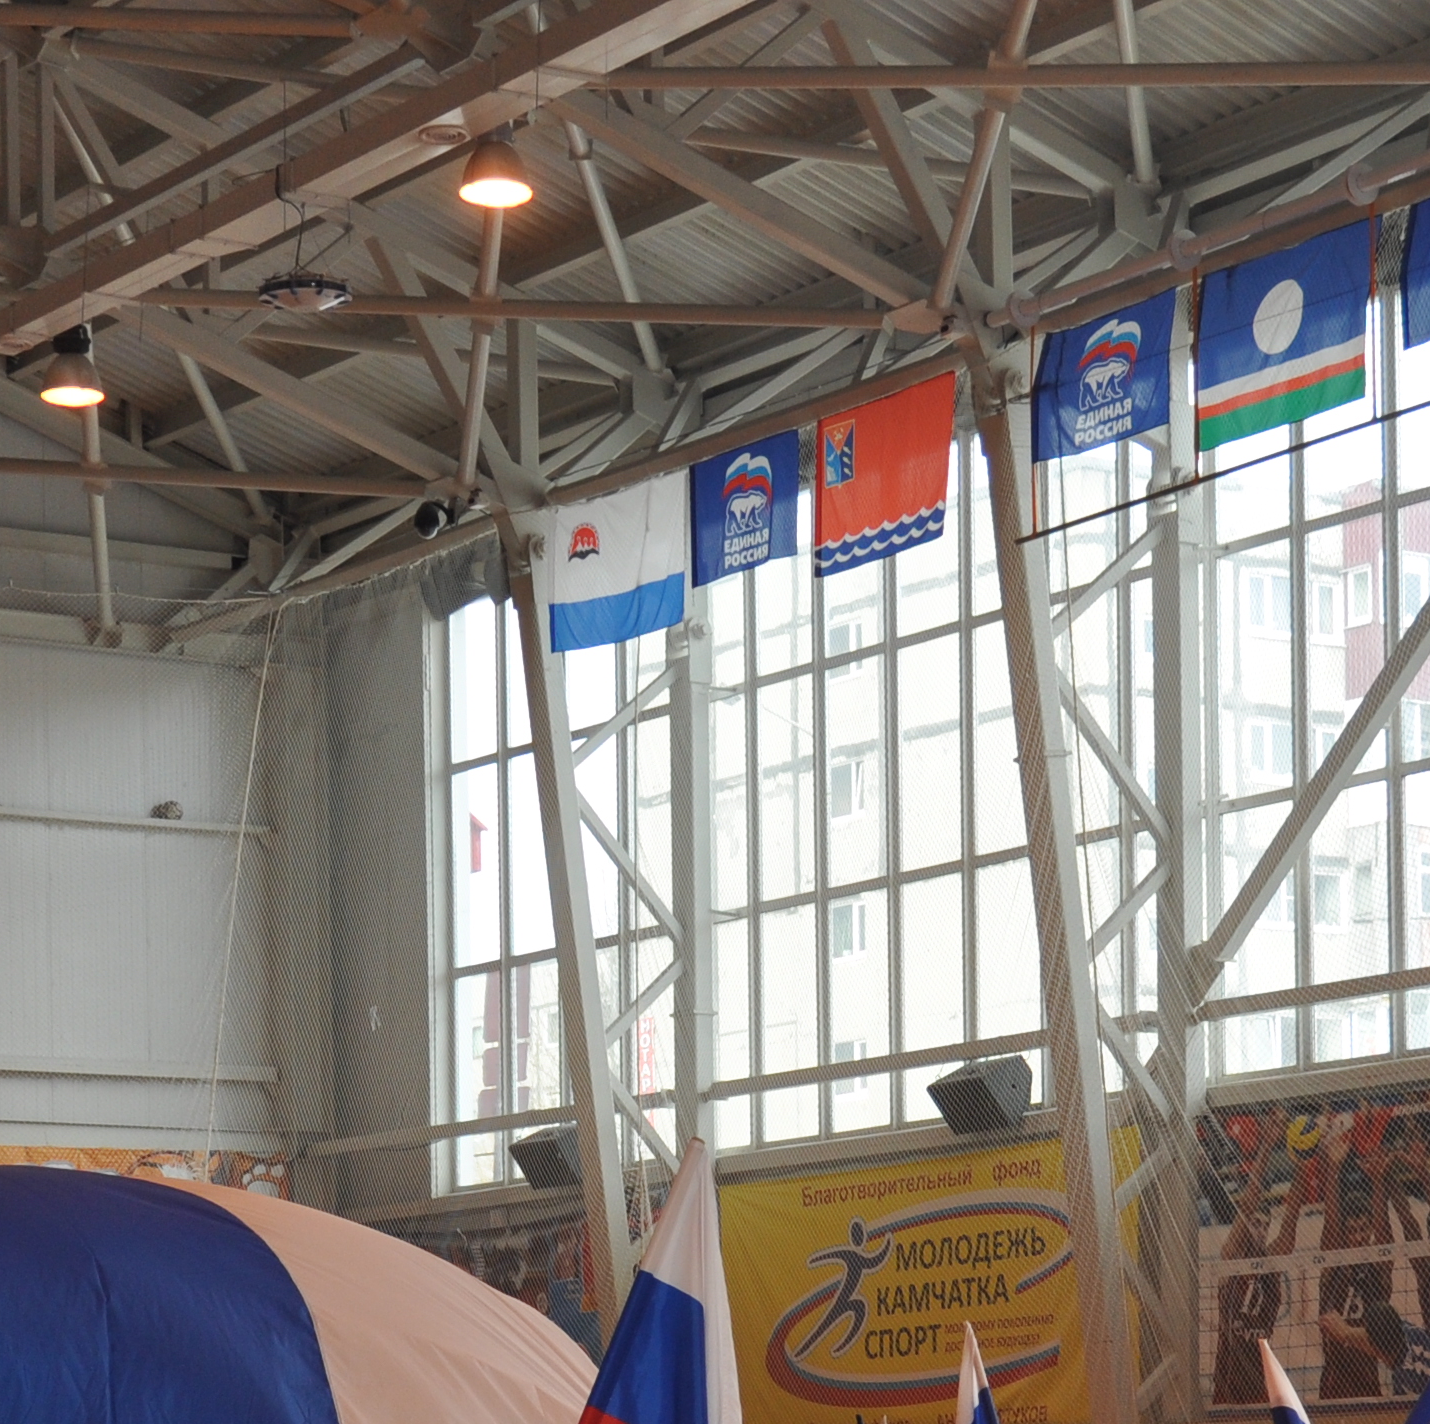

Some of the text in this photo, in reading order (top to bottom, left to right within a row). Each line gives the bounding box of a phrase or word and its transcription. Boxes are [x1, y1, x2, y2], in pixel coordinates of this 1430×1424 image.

[1074, 415, 1132, 447] РОССИЯ
[1075, 397, 1132, 430] ЕДИНАЯ
[723, 527, 770, 554] ЕДИНАЯ
[723, 543, 770, 569] РОССИЯ
[801, 1157, 1042, 1208] Благотворительный фонд
[894, 1225, 1048, 1272] МОЛОДЕЖЬ
[876, 1274, 1010, 1317] КАМЧАТКА
[864, 1323, 942, 1360] СПОРТ
